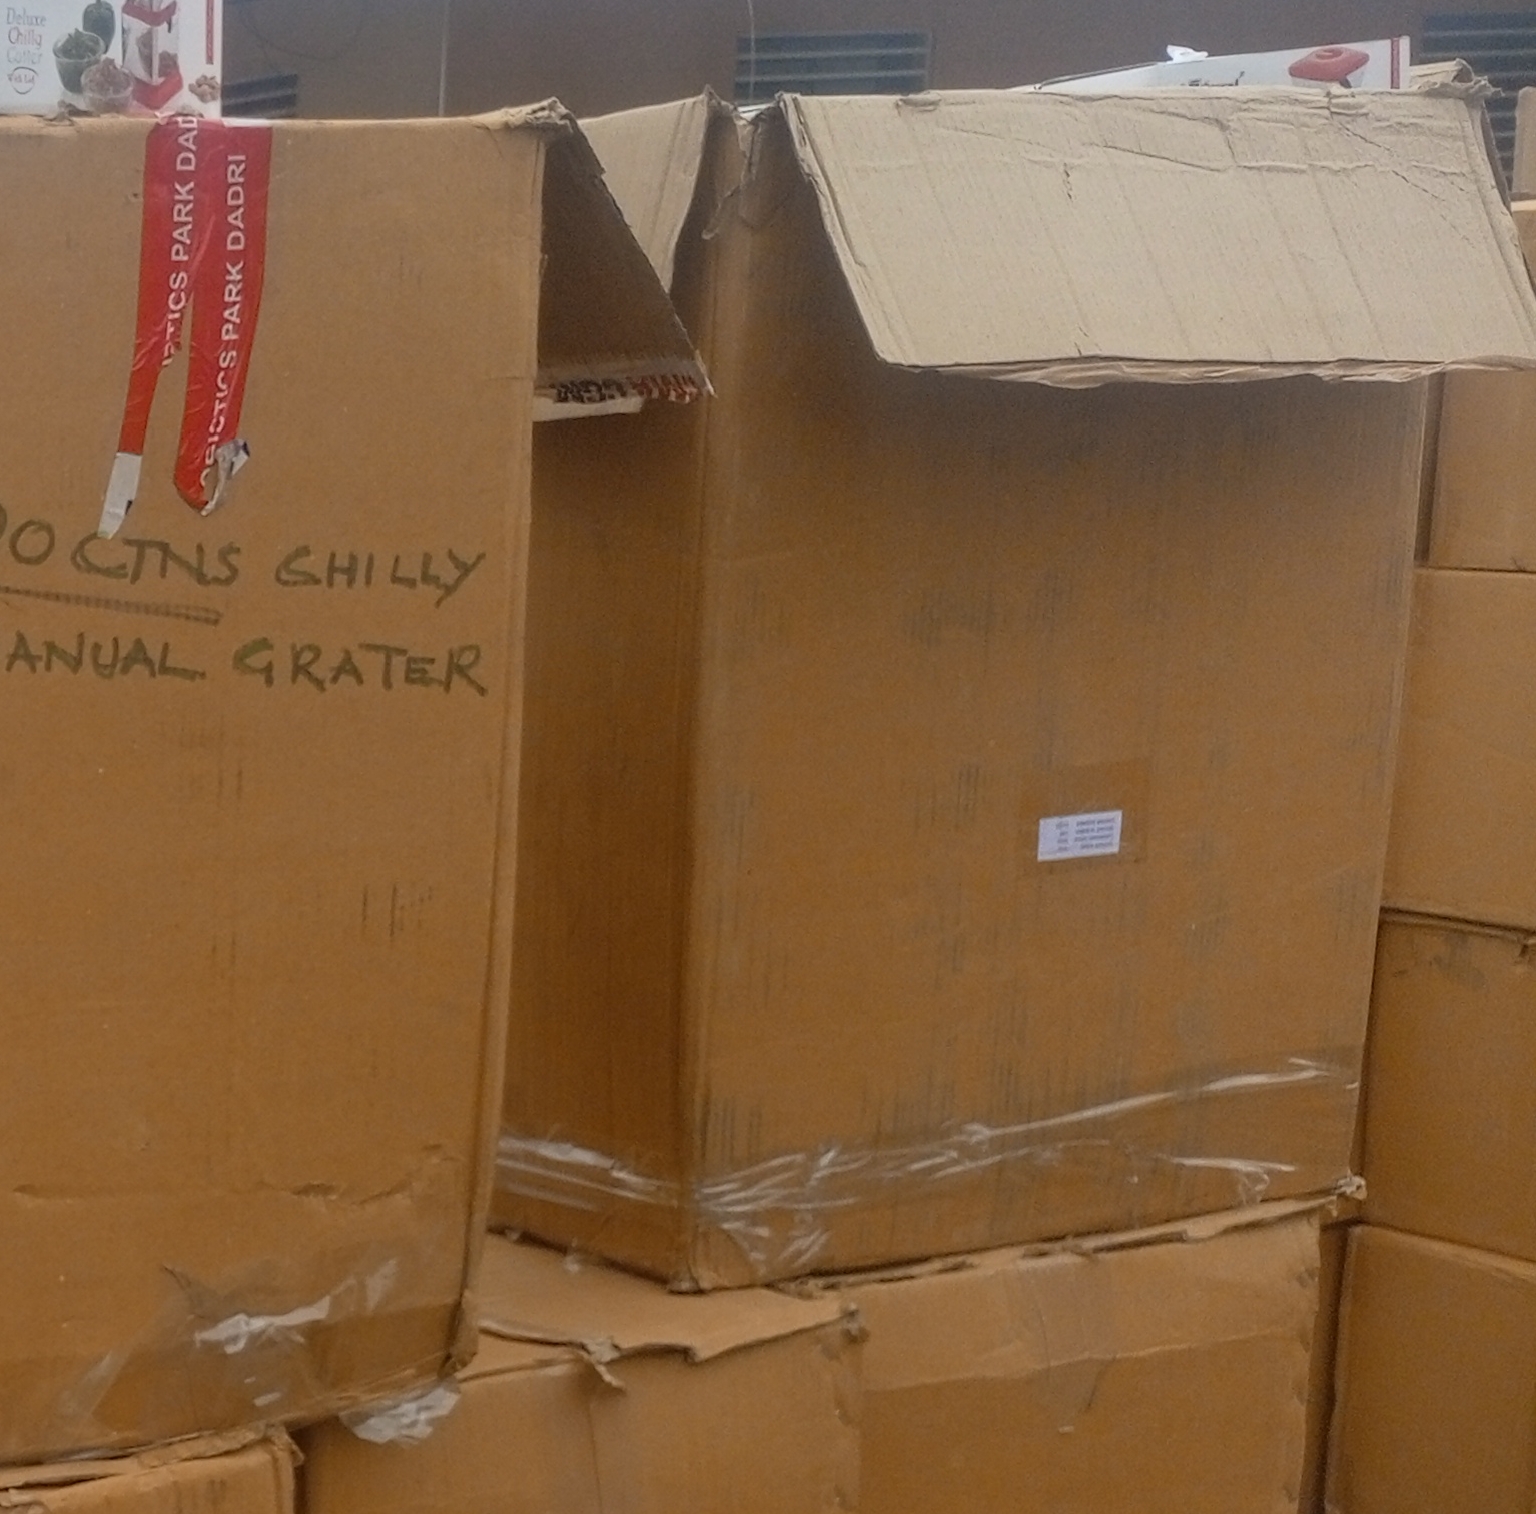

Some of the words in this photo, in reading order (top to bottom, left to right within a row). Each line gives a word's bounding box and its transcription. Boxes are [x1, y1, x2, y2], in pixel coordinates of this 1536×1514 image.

[6, 7, 47, 26] Deluxe
[8, 27, 43, 49] Chilly
[170, 180, 195, 263] PARK
[227, 154, 247, 250] DADRI
[220, 261, 244, 342] PARK
[70, 530, 242, 586] CTNS
[232, 636, 487, 697] GRATER
